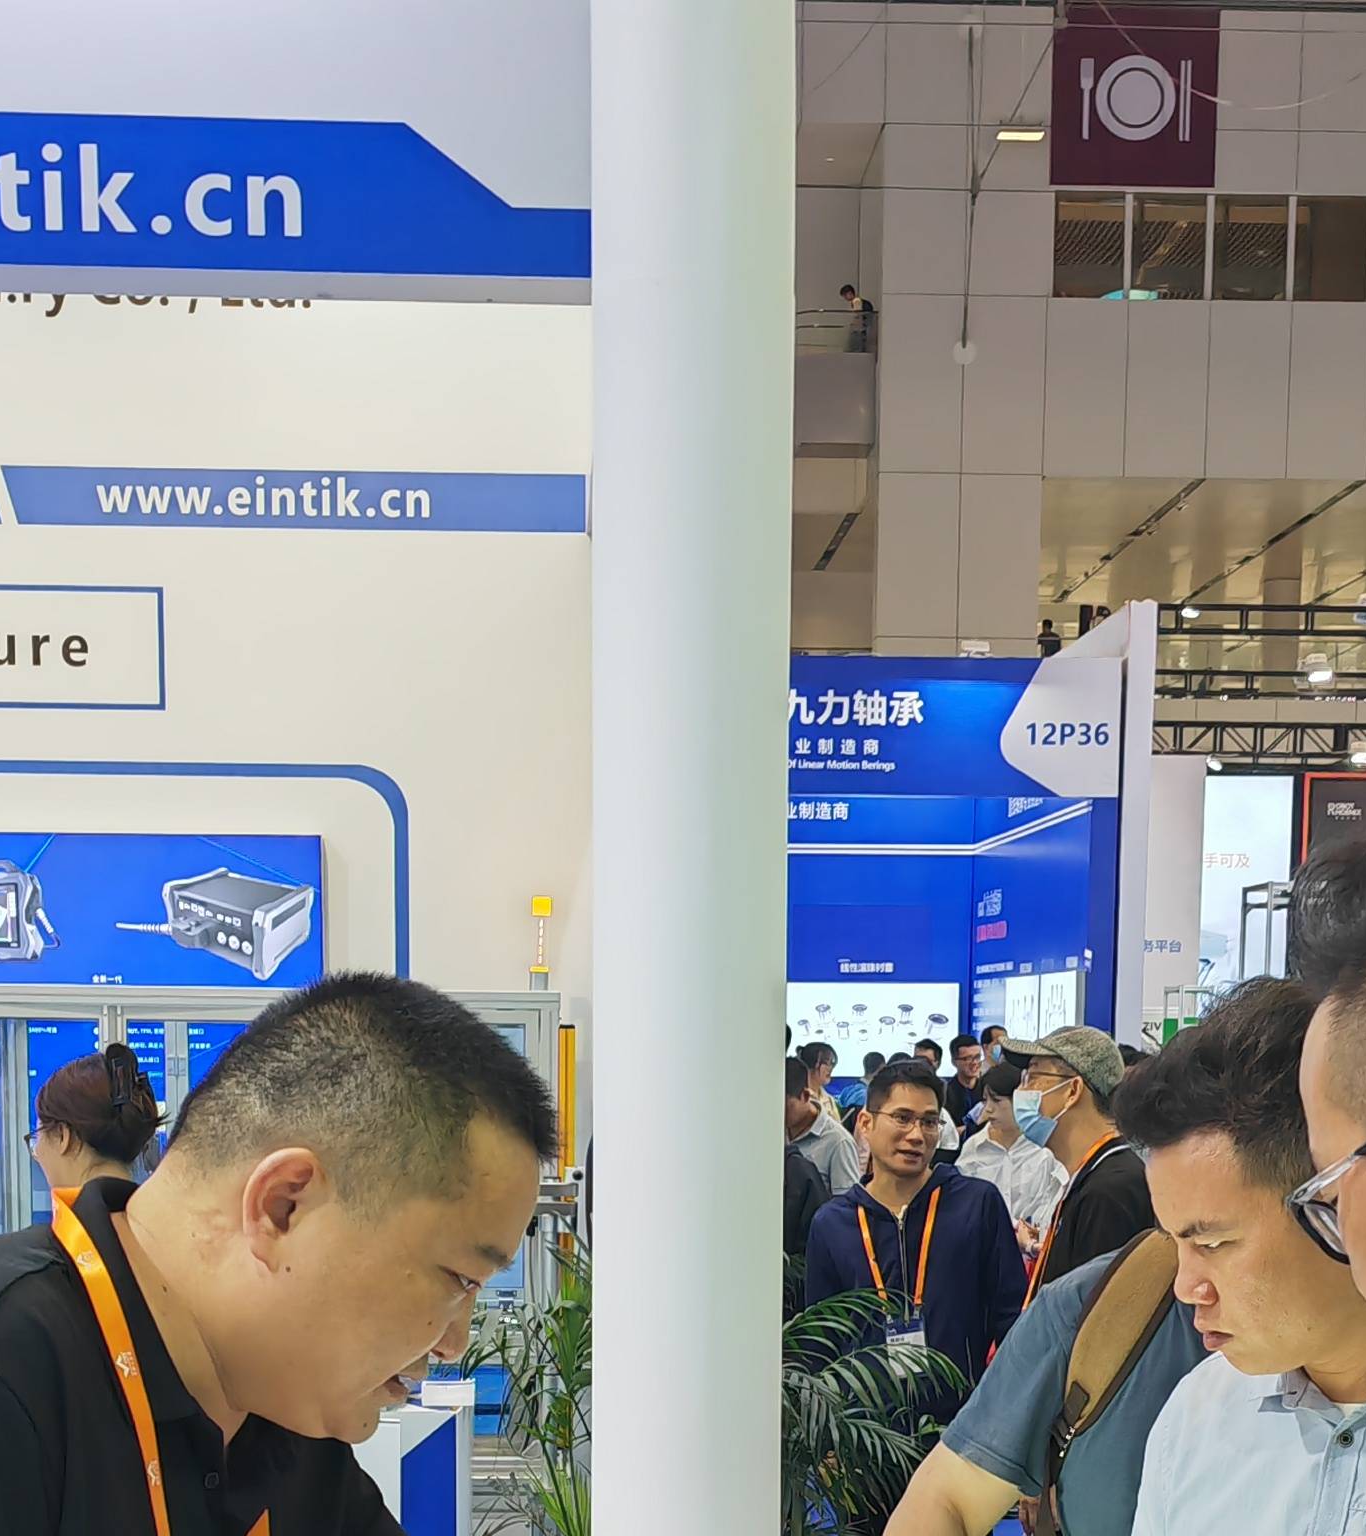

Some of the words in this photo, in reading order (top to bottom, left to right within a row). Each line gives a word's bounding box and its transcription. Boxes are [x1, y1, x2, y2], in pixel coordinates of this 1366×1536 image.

[96, 475, 432, 519] www.eintik.cn
[788, 689, 925, 727] 九力轴承
[1026, 721, 1110, 746] 12P36
[826, 759, 860, 770] Motion
